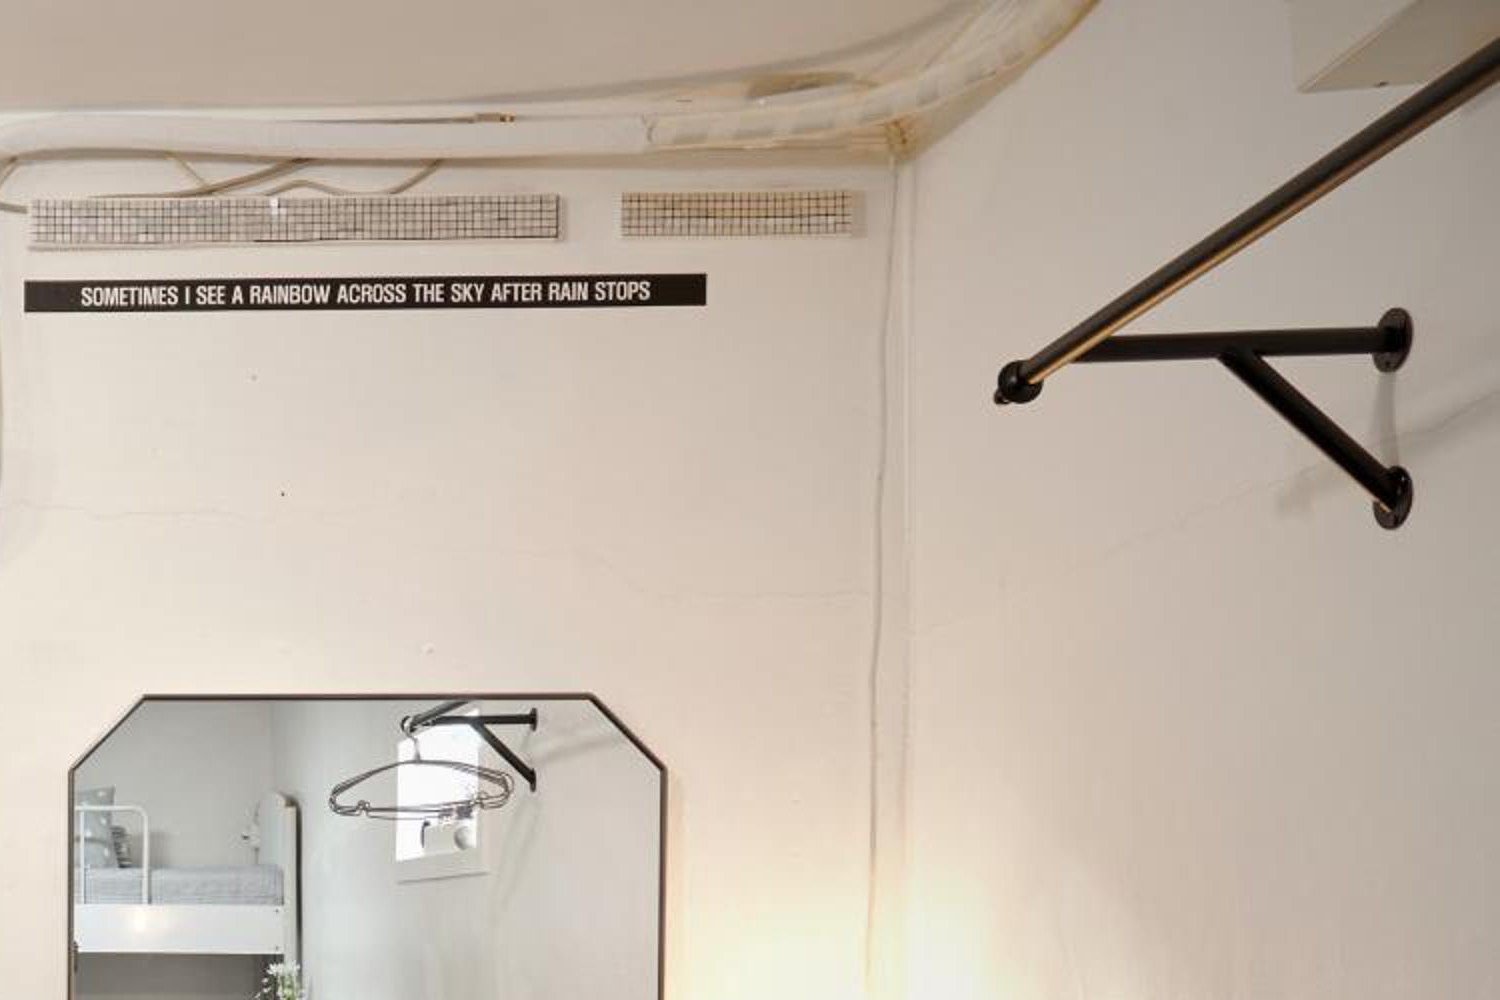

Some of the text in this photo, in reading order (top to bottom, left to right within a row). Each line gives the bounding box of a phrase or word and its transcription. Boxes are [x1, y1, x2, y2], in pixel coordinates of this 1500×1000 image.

[80, 281, 651, 307] SOMETIMES I SEE A RAINBOW ACROSS THE SKY AFTER RAIN STOPS
